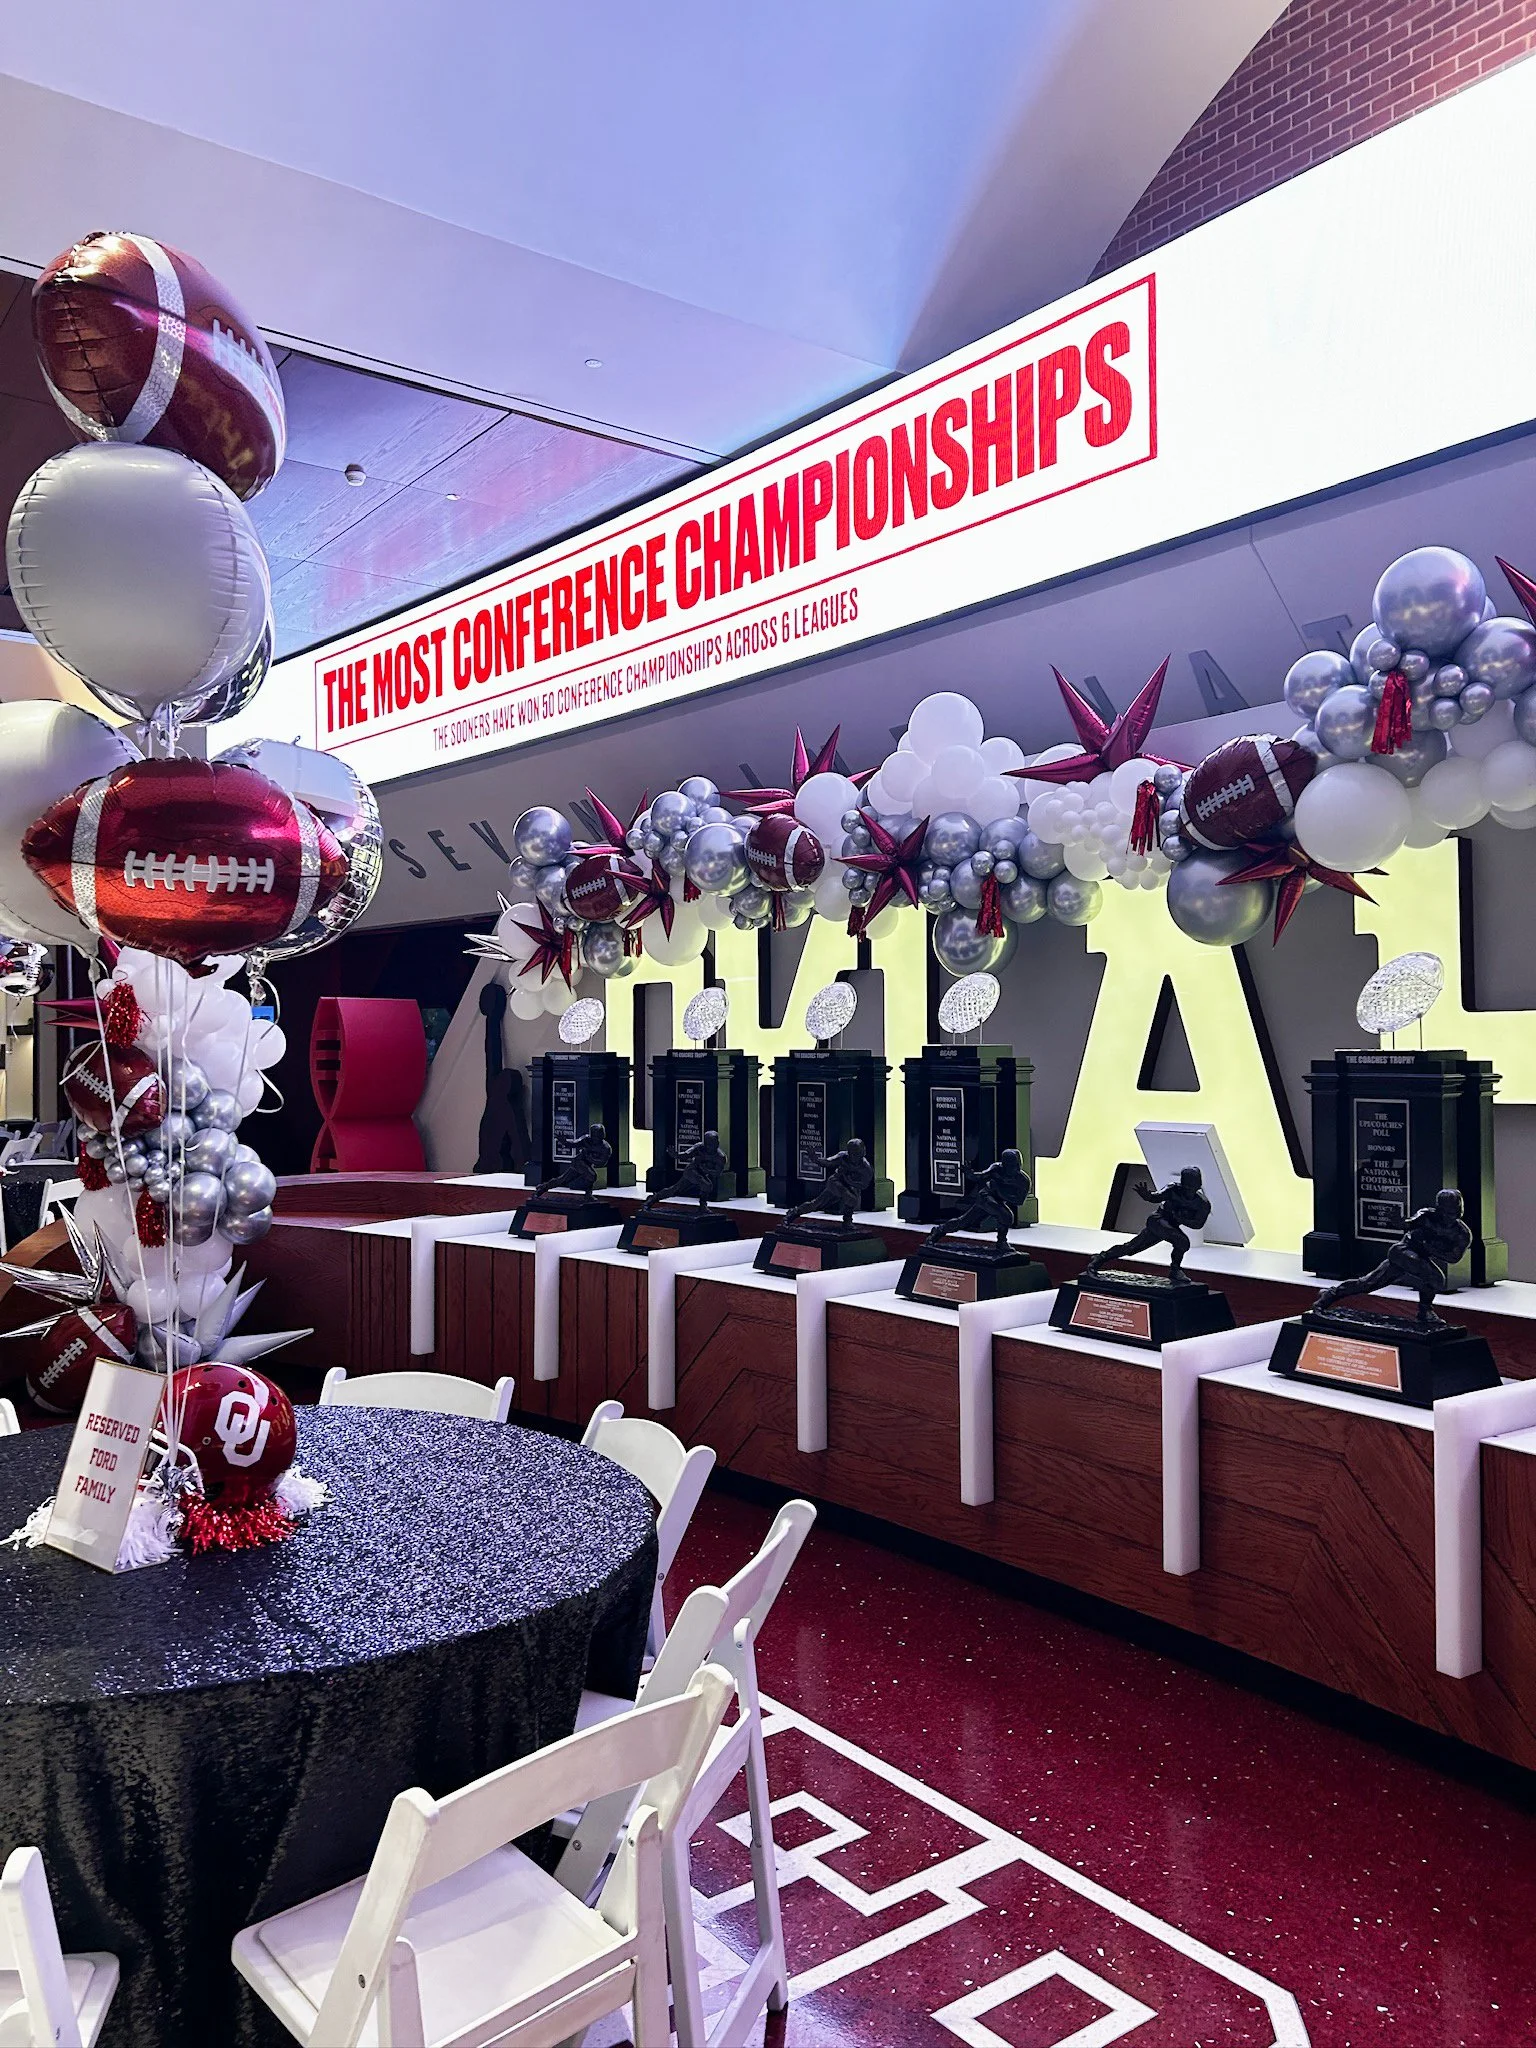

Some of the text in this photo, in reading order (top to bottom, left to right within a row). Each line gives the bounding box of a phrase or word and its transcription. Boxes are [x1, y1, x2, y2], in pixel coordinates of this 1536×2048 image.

[324, 322, 1133, 733] THE MOST CONFERENCE CHAMPIONSHIPS
[432, 588, 859, 751] THE SOONERS HAVE WON 50 CONFERENCE CHAMPIONSHIPS ACROSS 6 LEAGUES
[1346, 1055, 1415, 1064] THE COACHES' TROPHY
[1374, 1113, 1388, 1121] THE
[1359, 1120, 1404, 1129] UPI/COACHES'
[1372, 1128, 1390, 1137] POLL
[1367, 1144, 1396, 1152] HONORS
[1374, 1160, 1389, 1168] THE
[1364, 1168, 1400, 1177] NATIONAL
[1361, 1176, 1403, 1185] FOOTBALL
[1361, 1184, 1404, 1193] CHAMPION
[85, 1413, 140, 1444] RESERVED
[214, 1390, 271, 1468] OU
[89, 1447, 118, 1472] FORD
[74, 1475, 116, 1504] FAMILY
